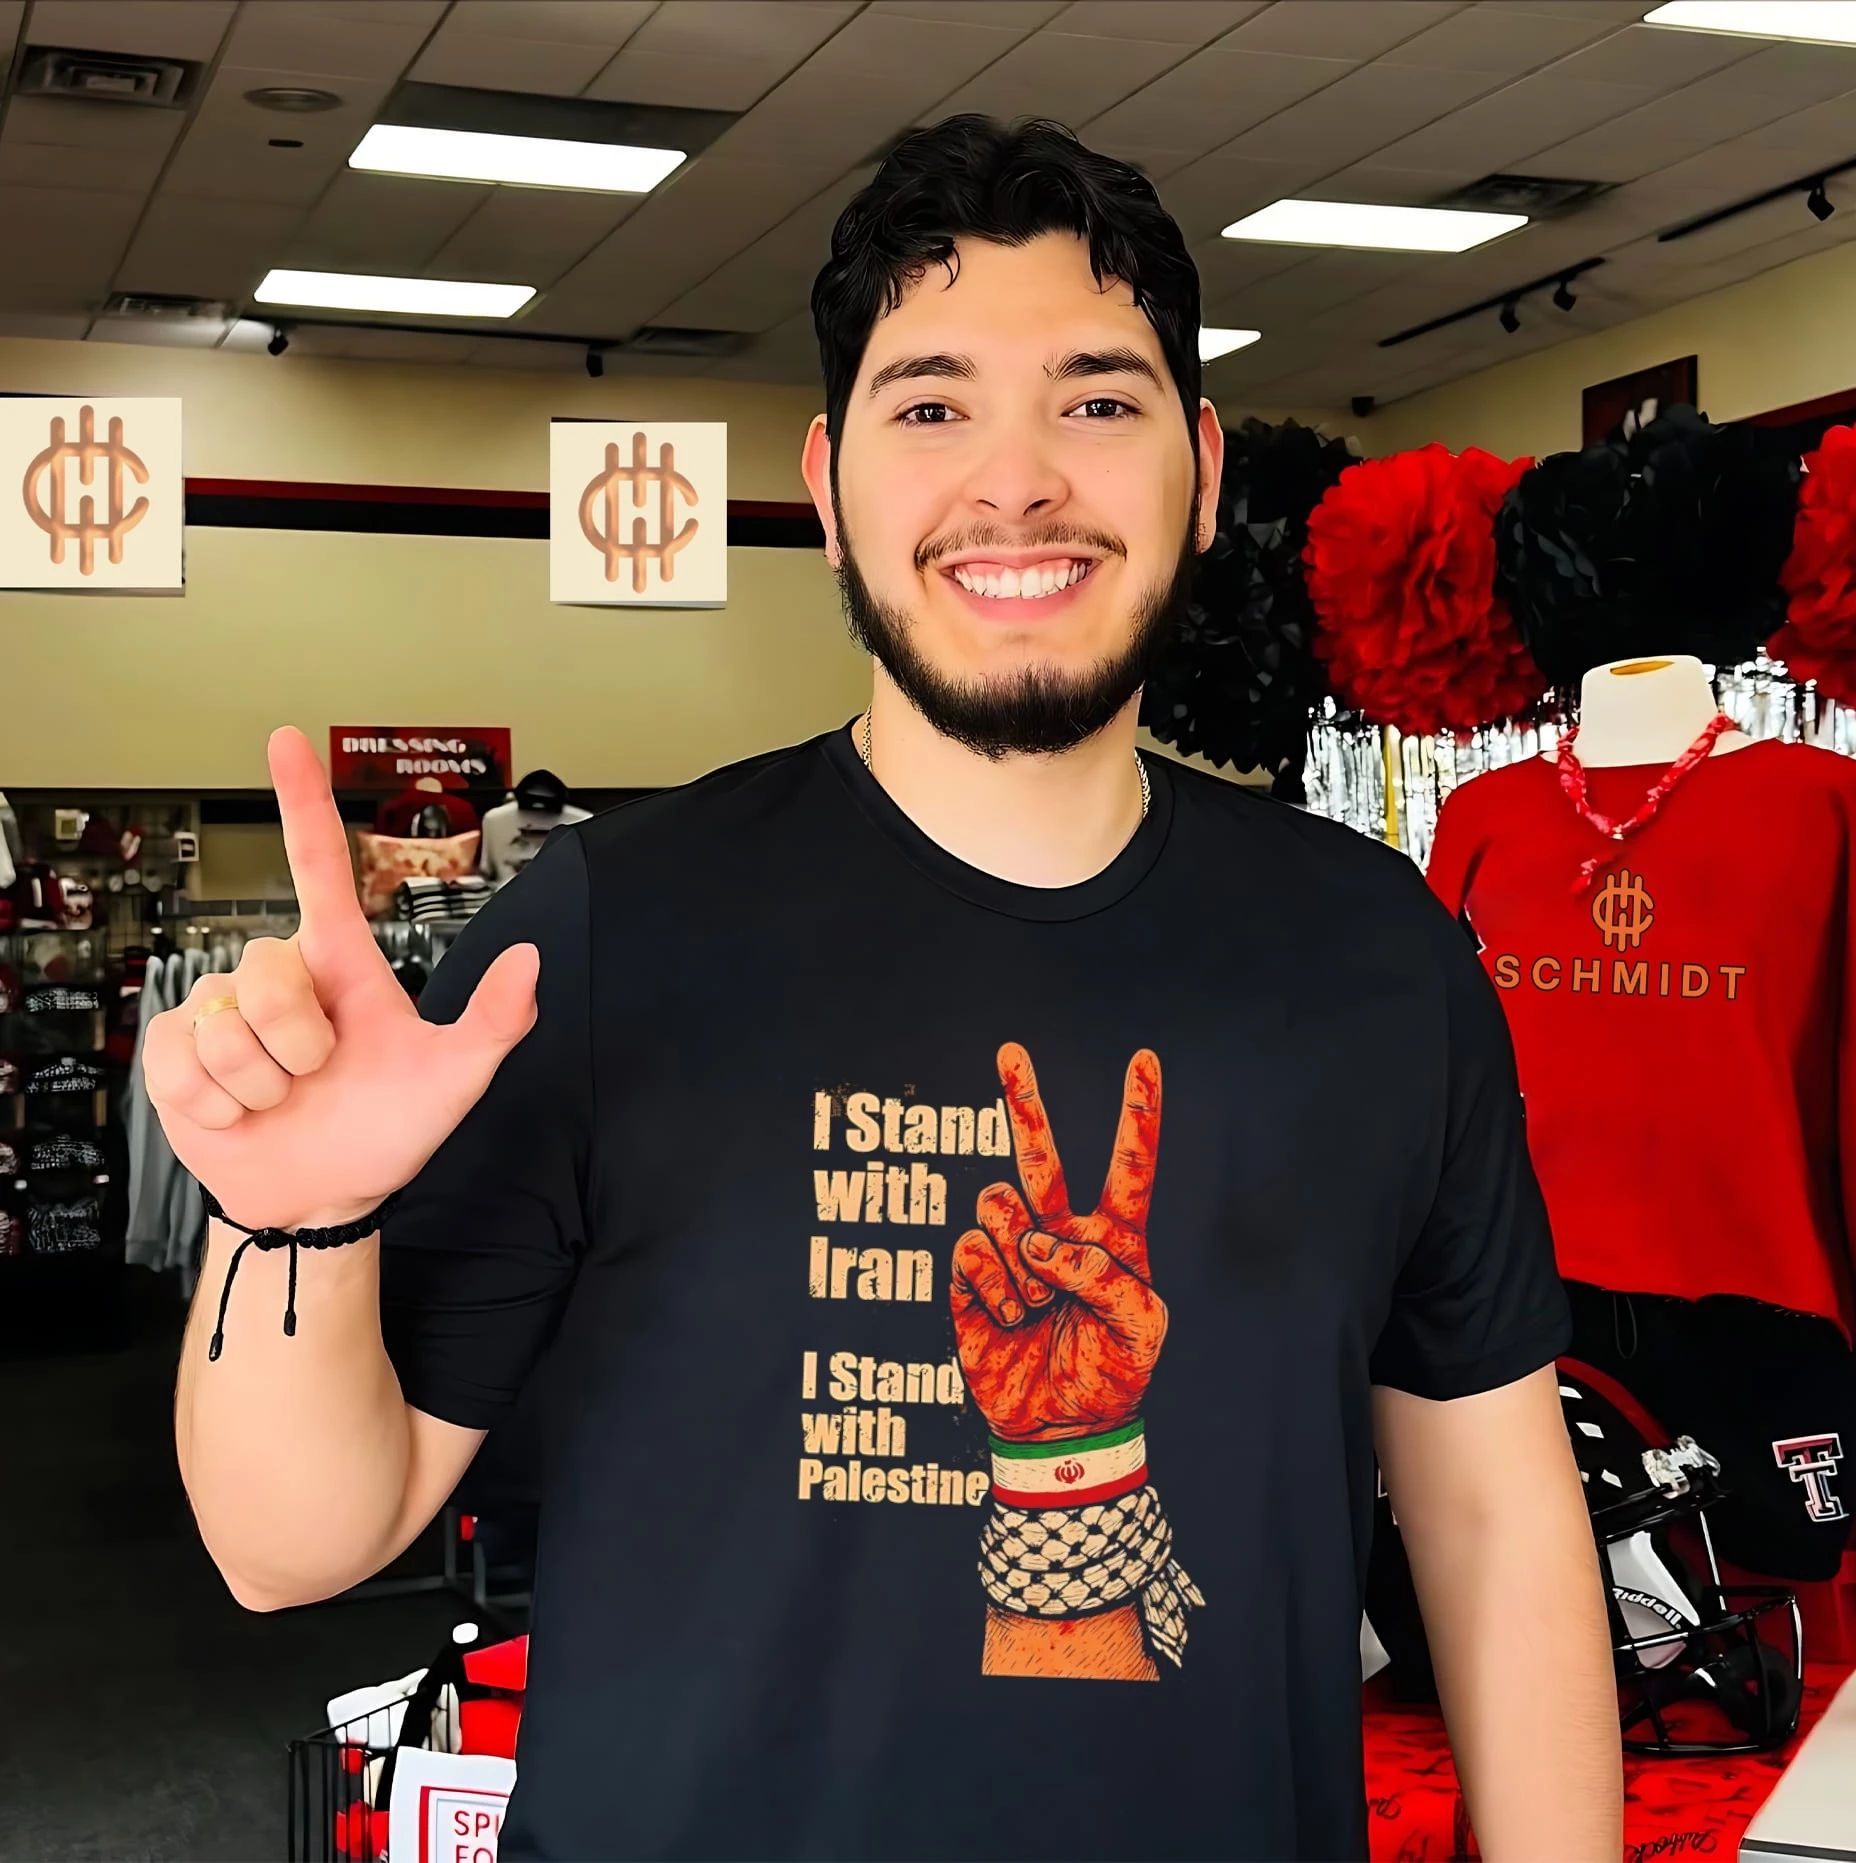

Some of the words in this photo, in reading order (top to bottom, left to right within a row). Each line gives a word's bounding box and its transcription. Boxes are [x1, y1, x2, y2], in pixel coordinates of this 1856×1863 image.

[342, 737, 466, 753] DRESSING
[396, 758, 487, 774] ROOMS
[1494, 955, 1746, 999] SCHMIDT
[813, 1091, 832, 1151] I
[845, 1092, 1010, 1157] Stand
[813, 1160, 946, 1225] with
[808, 1236, 934, 1302] Iran
[802, 1351, 818, 1400] I
[829, 1352, 965, 1405] Stand
[801, 1407, 906, 1457] with
[798, 1458, 989, 1507] Palestine
